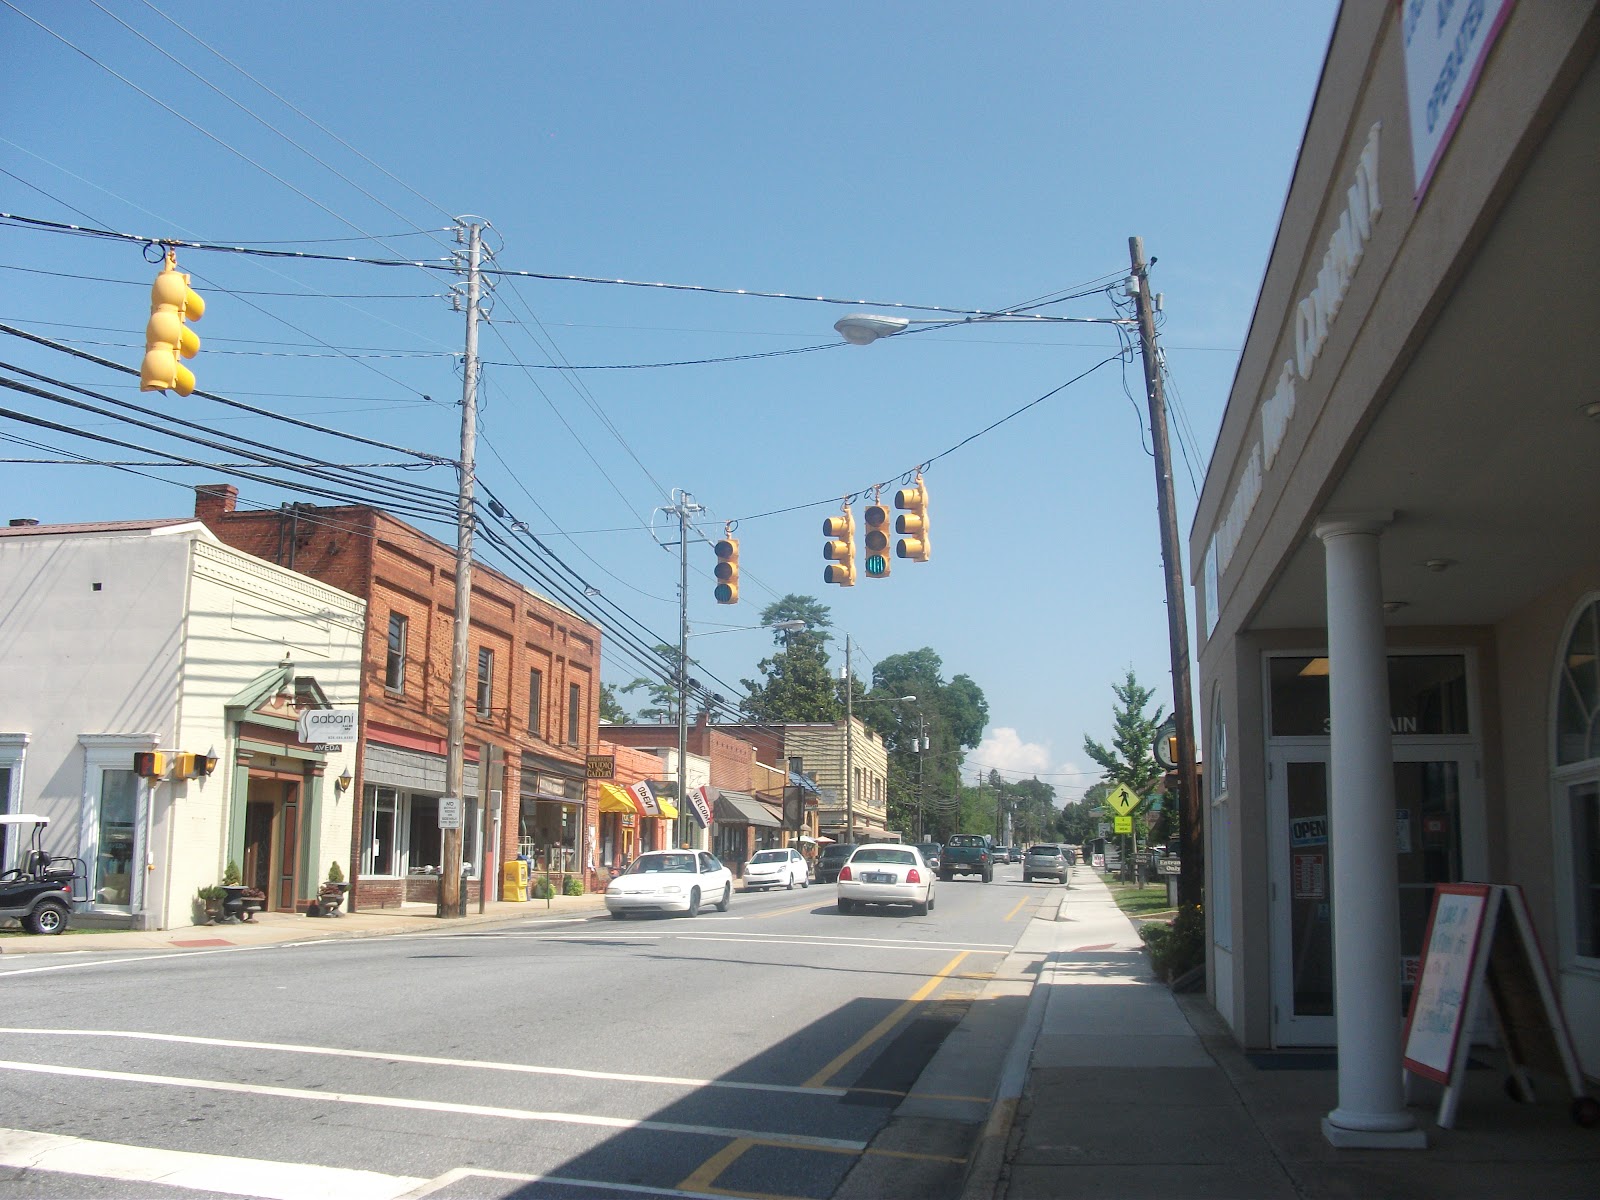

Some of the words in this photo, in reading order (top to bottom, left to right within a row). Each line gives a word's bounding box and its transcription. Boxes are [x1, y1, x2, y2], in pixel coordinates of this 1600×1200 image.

[311, 713, 354, 724] aabani
[587, 769, 612, 777] GALLERY
[1293, 820, 1326, 839] OPEN
